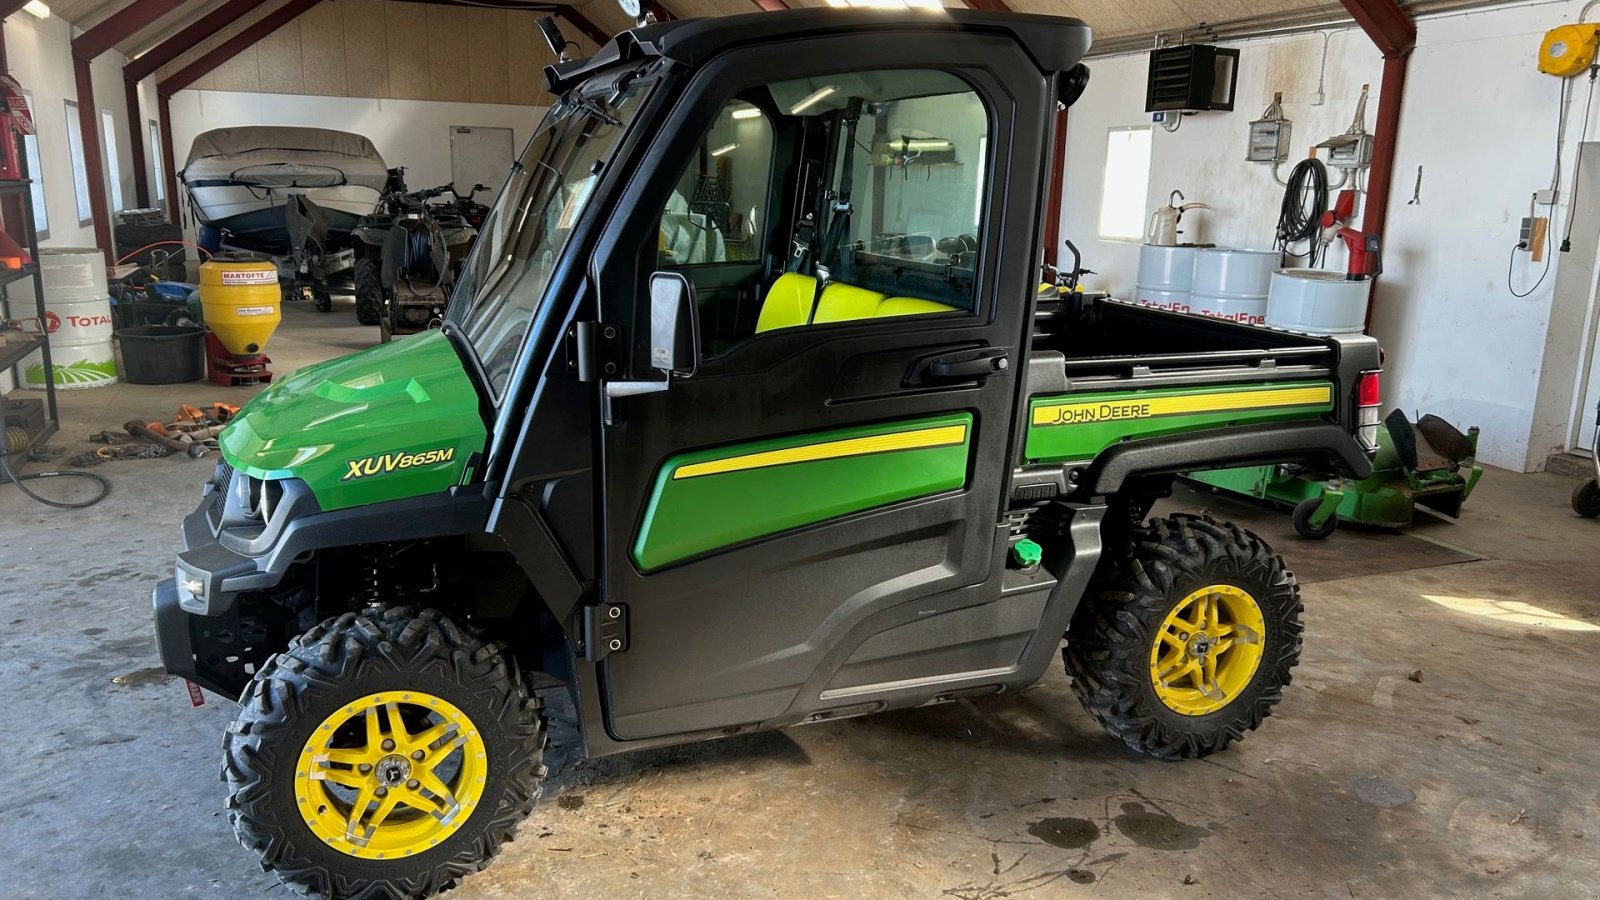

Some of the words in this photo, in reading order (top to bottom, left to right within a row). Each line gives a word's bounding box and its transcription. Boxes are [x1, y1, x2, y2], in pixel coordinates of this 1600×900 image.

[223, 272, 265, 280] MARTOFTE
[65, 314, 112, 327] TOTAL
[1052, 407, 1095, 423] JOHN
[1099, 404, 1150, 419] DEERE
[342, 447, 454, 480] XUV865M
